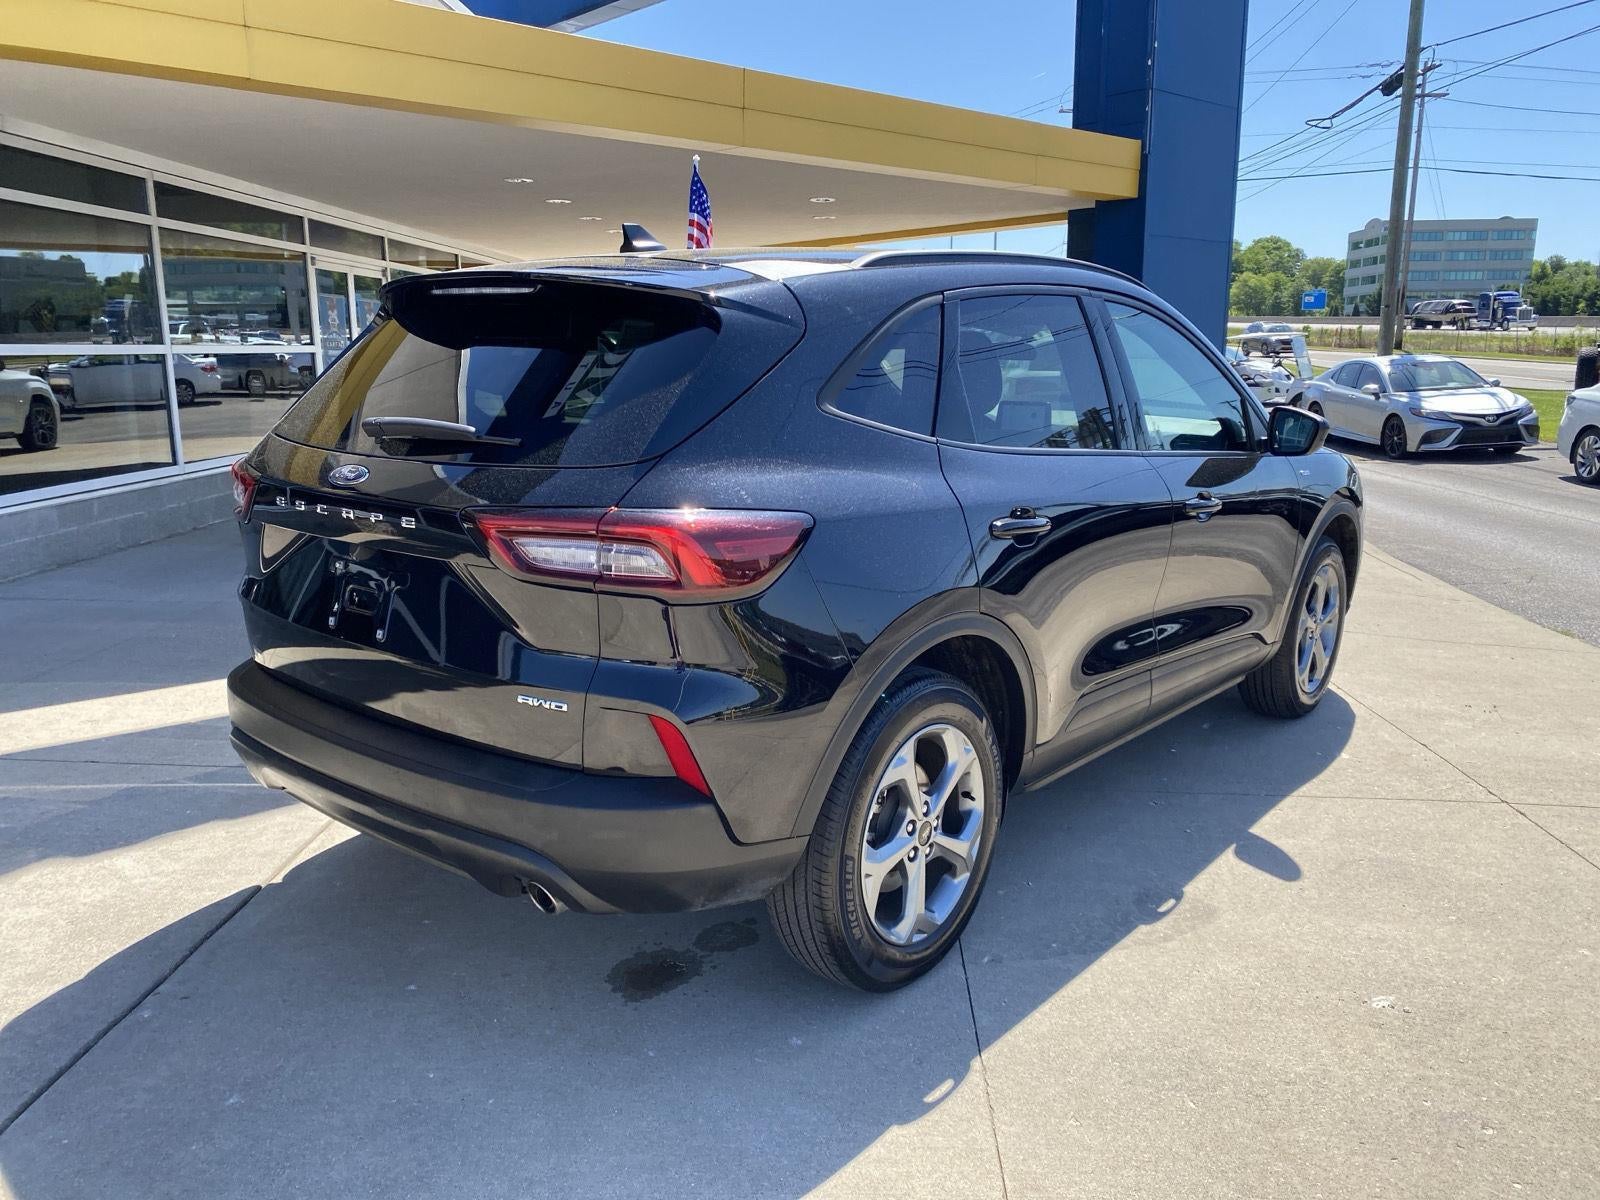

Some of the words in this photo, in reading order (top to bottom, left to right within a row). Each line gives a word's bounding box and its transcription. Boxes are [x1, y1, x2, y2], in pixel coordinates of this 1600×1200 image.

[275, 495, 416, 529] ESCAPE
[516, 694, 568, 712] AWD
[846, 858, 863, 941] MICHELIN
